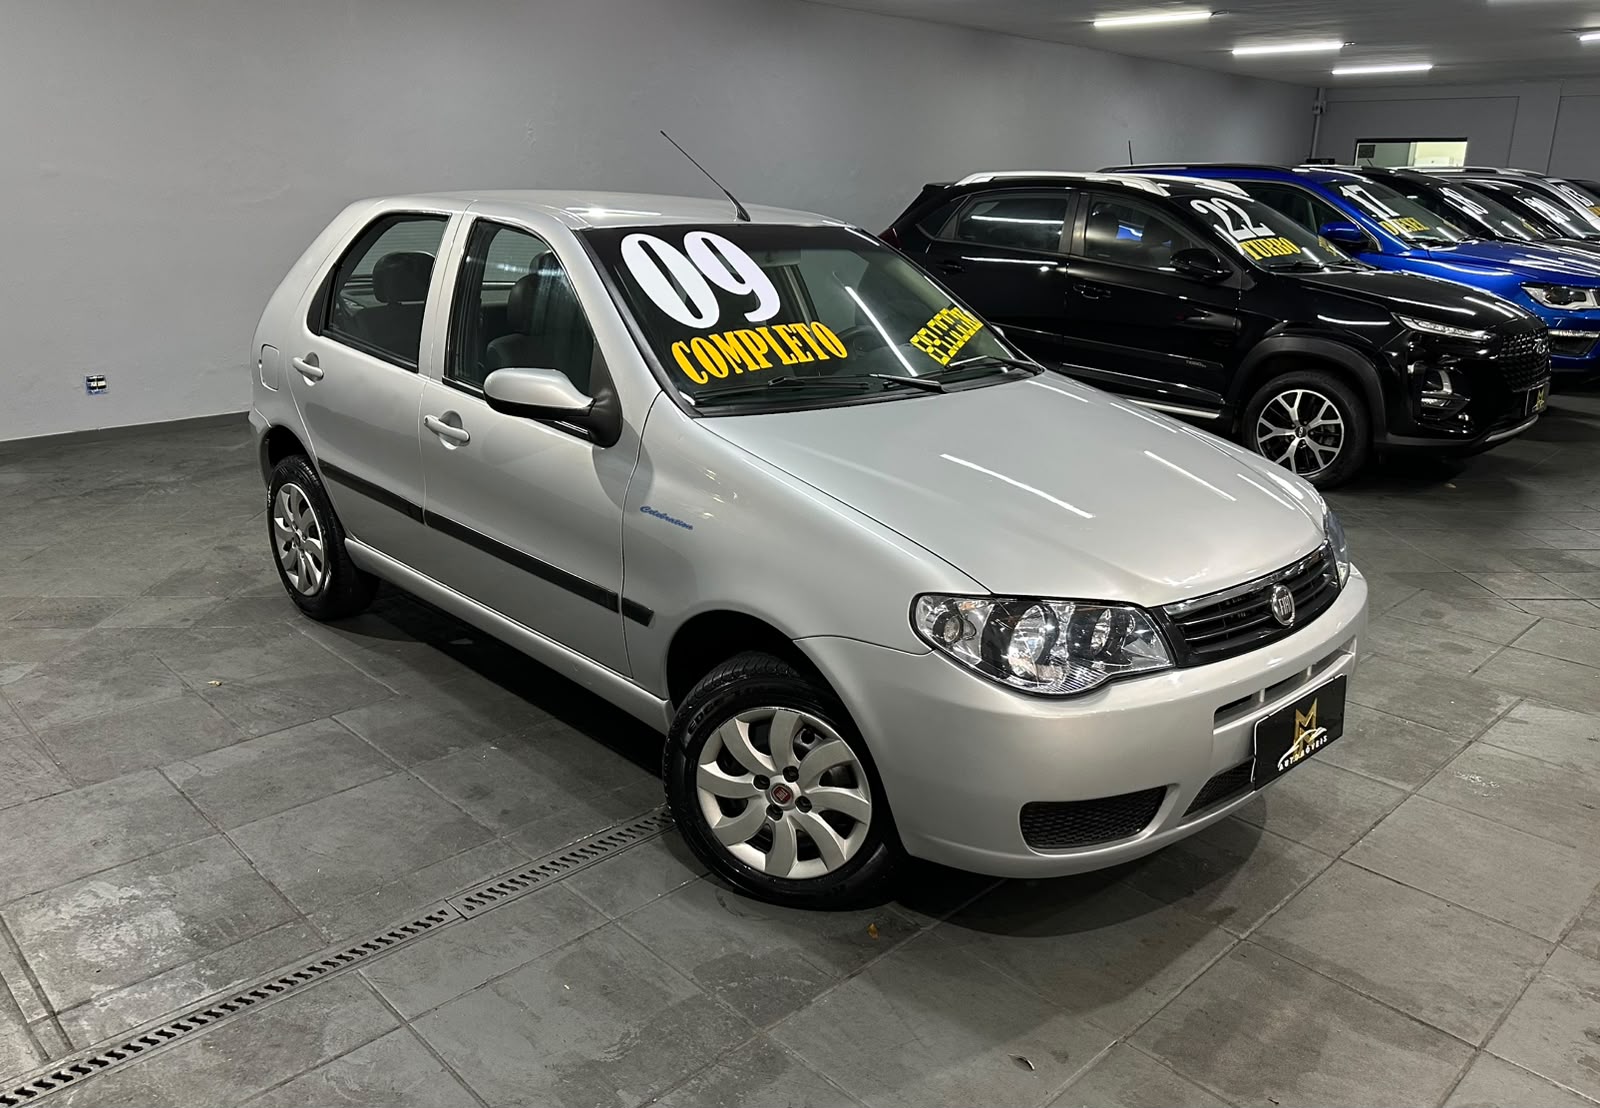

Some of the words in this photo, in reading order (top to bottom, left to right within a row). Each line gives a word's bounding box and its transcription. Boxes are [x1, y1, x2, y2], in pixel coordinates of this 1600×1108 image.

[1190, 198, 1276, 241] 22
[1339, 185, 1400, 219] 17
[1238, 237, 1301, 261] TURBO
[621, 231, 781, 329] 09
[671, 320, 848, 385] COMPLETO
